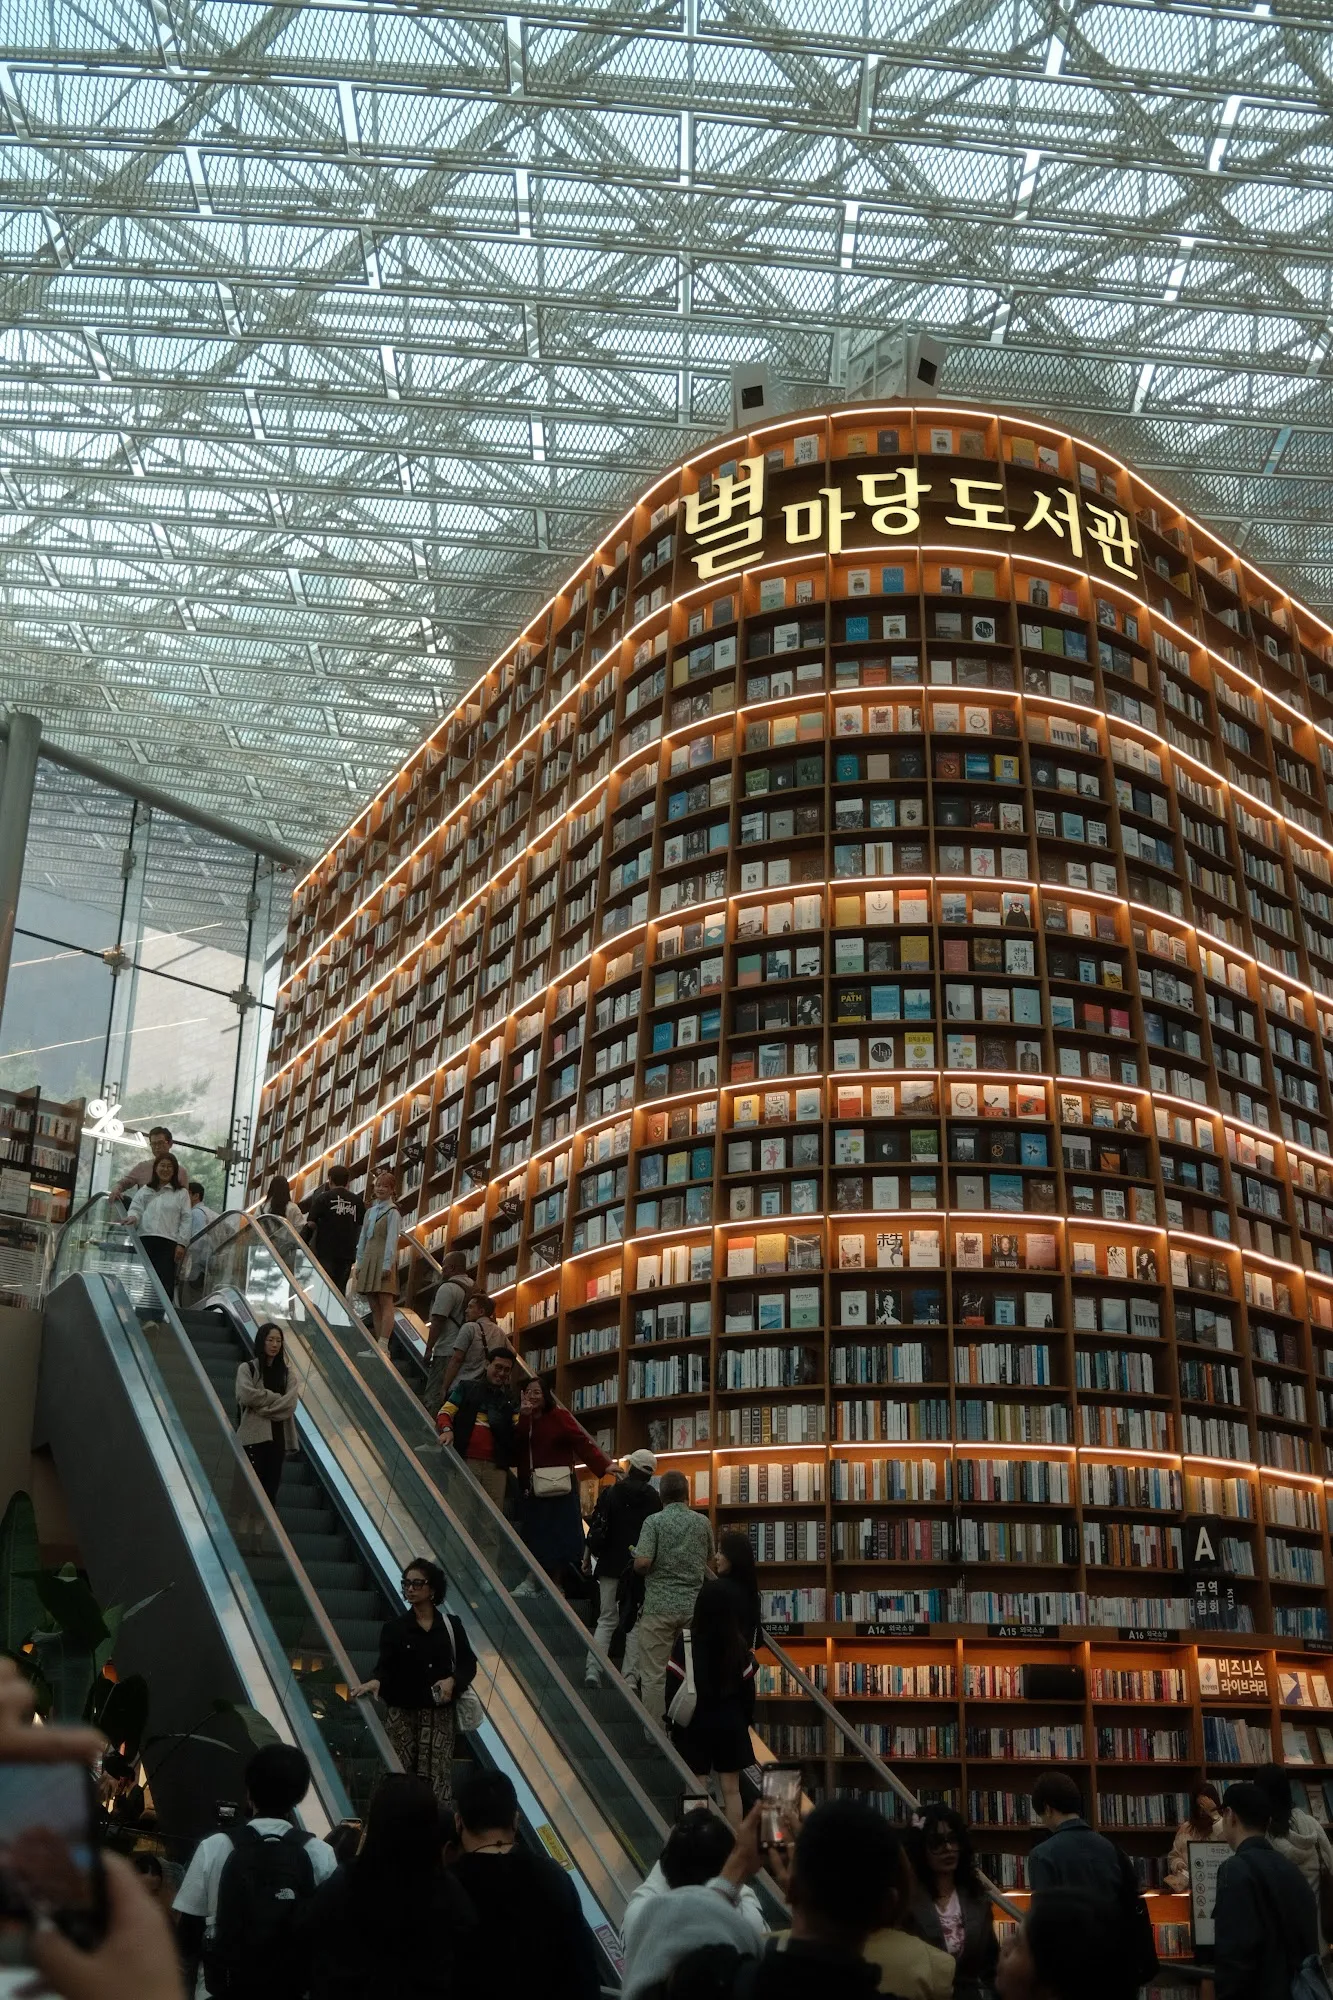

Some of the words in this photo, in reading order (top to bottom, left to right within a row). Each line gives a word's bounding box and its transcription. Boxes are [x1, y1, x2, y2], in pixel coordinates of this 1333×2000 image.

[680, 454, 932, 580] 별마당
[945, 477, 1140, 581] 도서관
[840, 994, 862, 1002] PATH
[540, 1244, 555, 1255] 주의
[1194, 1526, 1216, 1562] A
[1195, 1580, 1219, 1597] 무역
[1196, 1599, 1220, 1615] 협회
[1226, 1588, 1235, 1610] KITA
[867, 1626, 886, 1635] A14
[999, 1626, 1017, 1636] A15
[1128, 1630, 1144, 1640] A16
[1218, 1659, 1265, 1678] 비즈니스
[1221, 1679, 1268, 1696] 라이브러리
